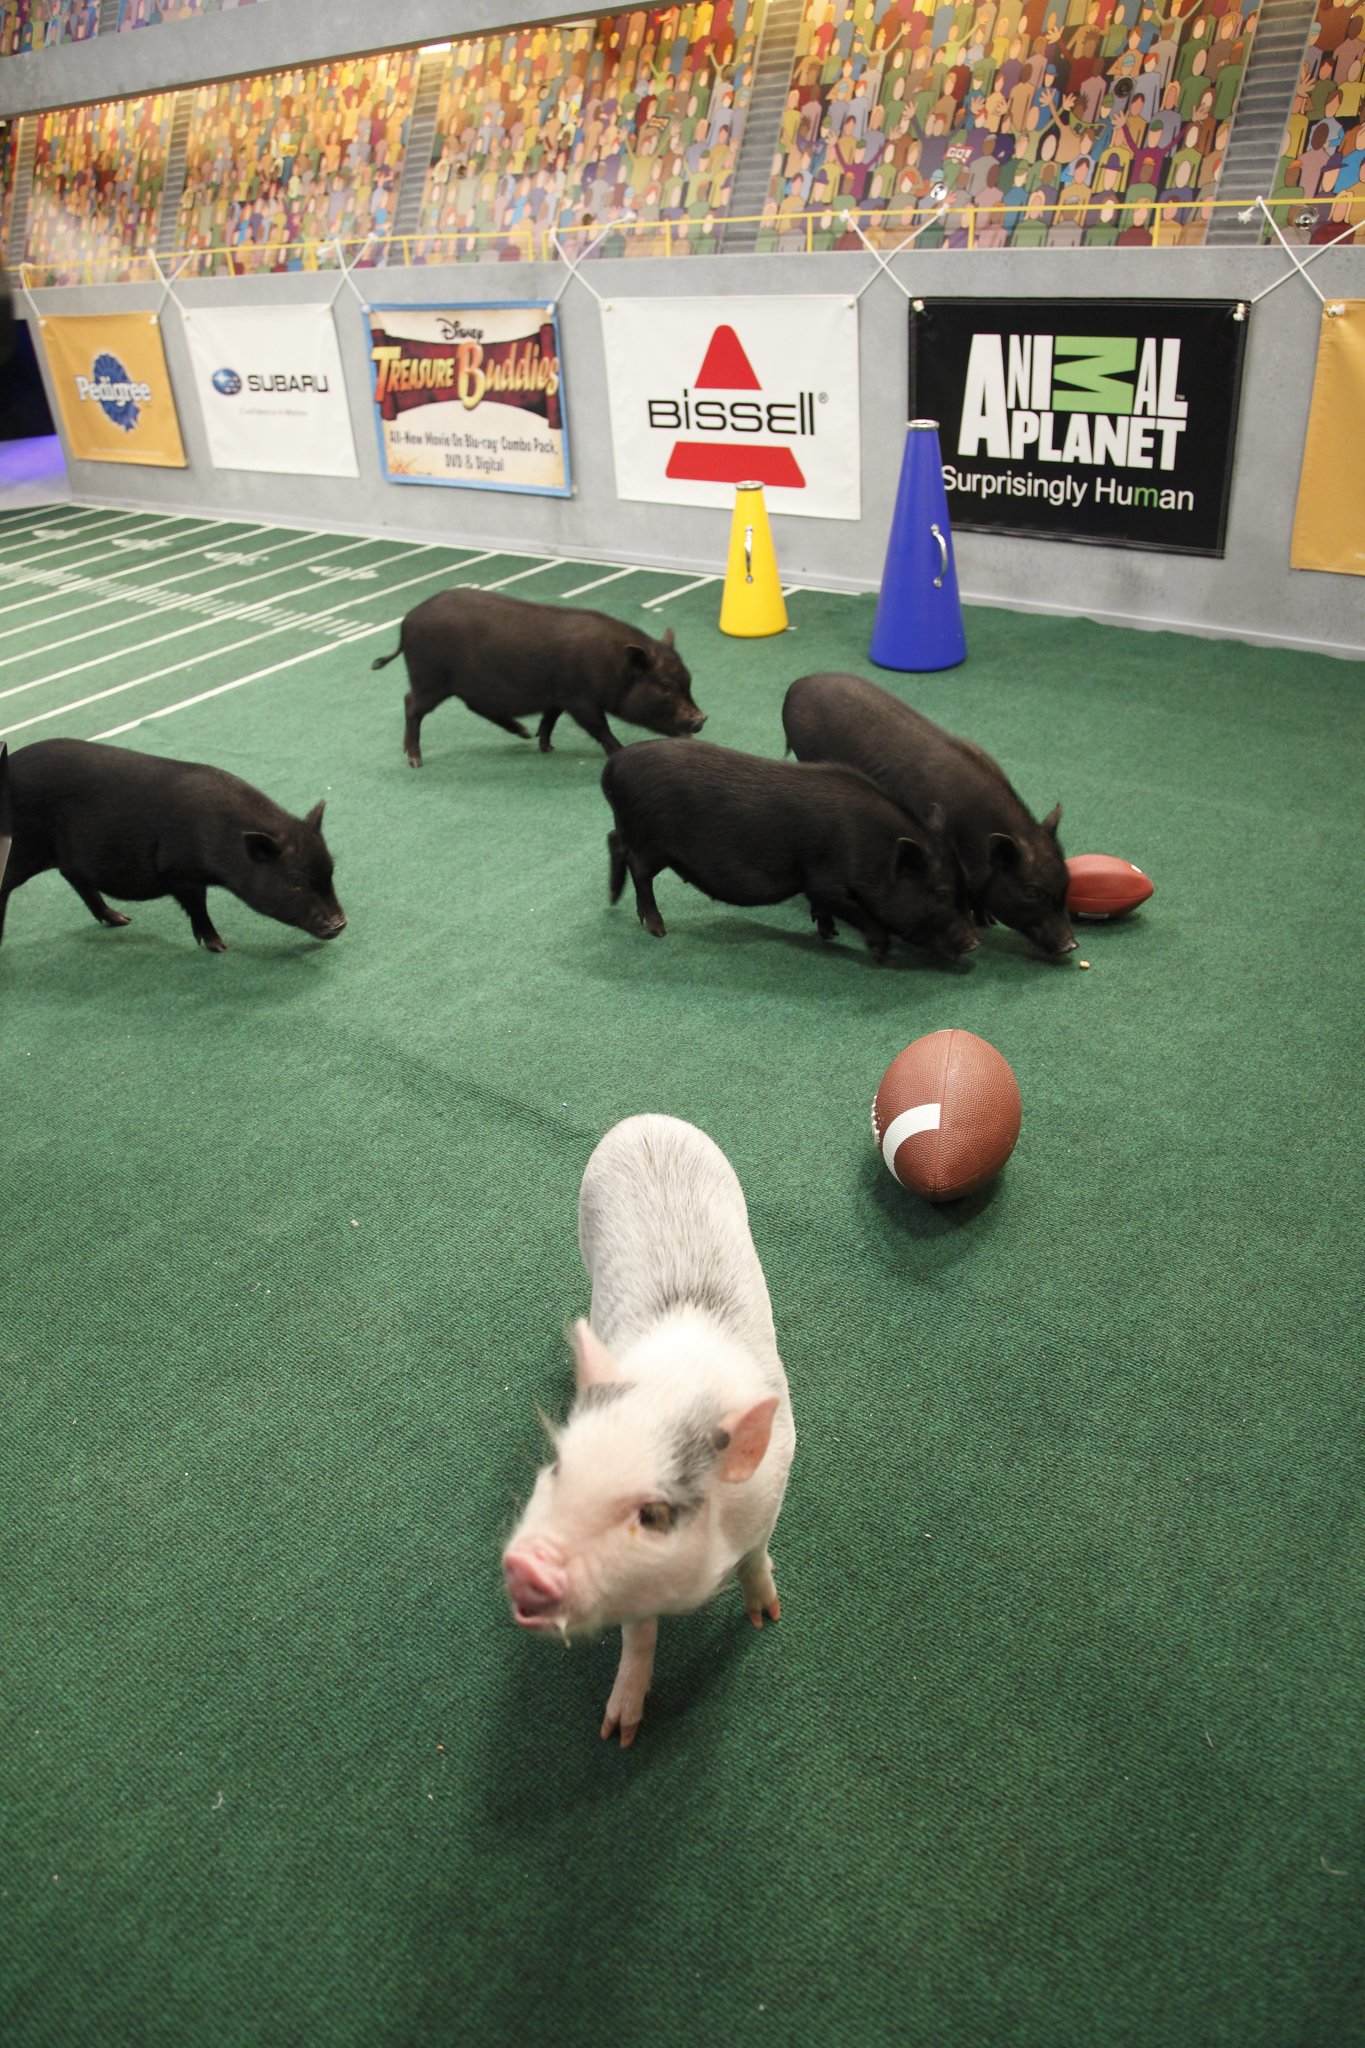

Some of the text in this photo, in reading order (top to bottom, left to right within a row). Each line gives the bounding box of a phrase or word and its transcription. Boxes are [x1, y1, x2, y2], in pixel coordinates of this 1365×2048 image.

[436, 318, 483, 345] Disney
[75, 376, 151, 407] Pedigree
[248, 375, 329, 393] SUBARU
[457, 341, 560, 411] Buddies
[957, 333, 1189, 459] ANIMAL
[1011, 409, 1187, 471] PLANET
[476, 455, 504, 473] Digital
[941, 464, 1194, 511] Surprisingly Human
